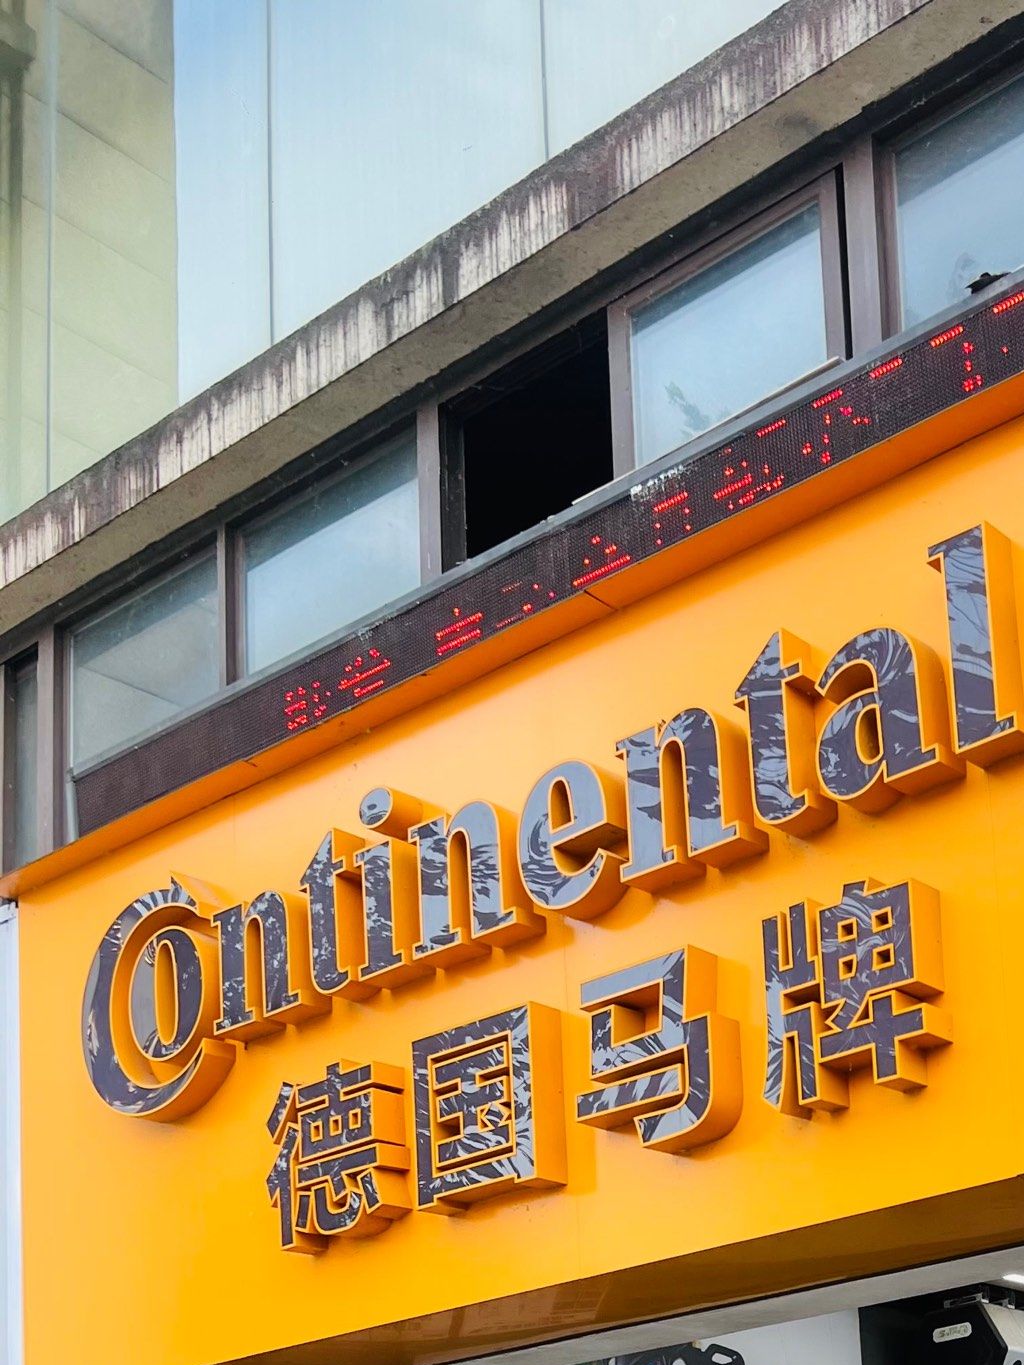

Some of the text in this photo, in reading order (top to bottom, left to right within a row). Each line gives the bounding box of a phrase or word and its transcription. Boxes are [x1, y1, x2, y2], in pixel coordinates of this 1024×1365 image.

[81, 520, 1020, 1120] Continental
[265, 876, 930, 1252] 德国马牌
